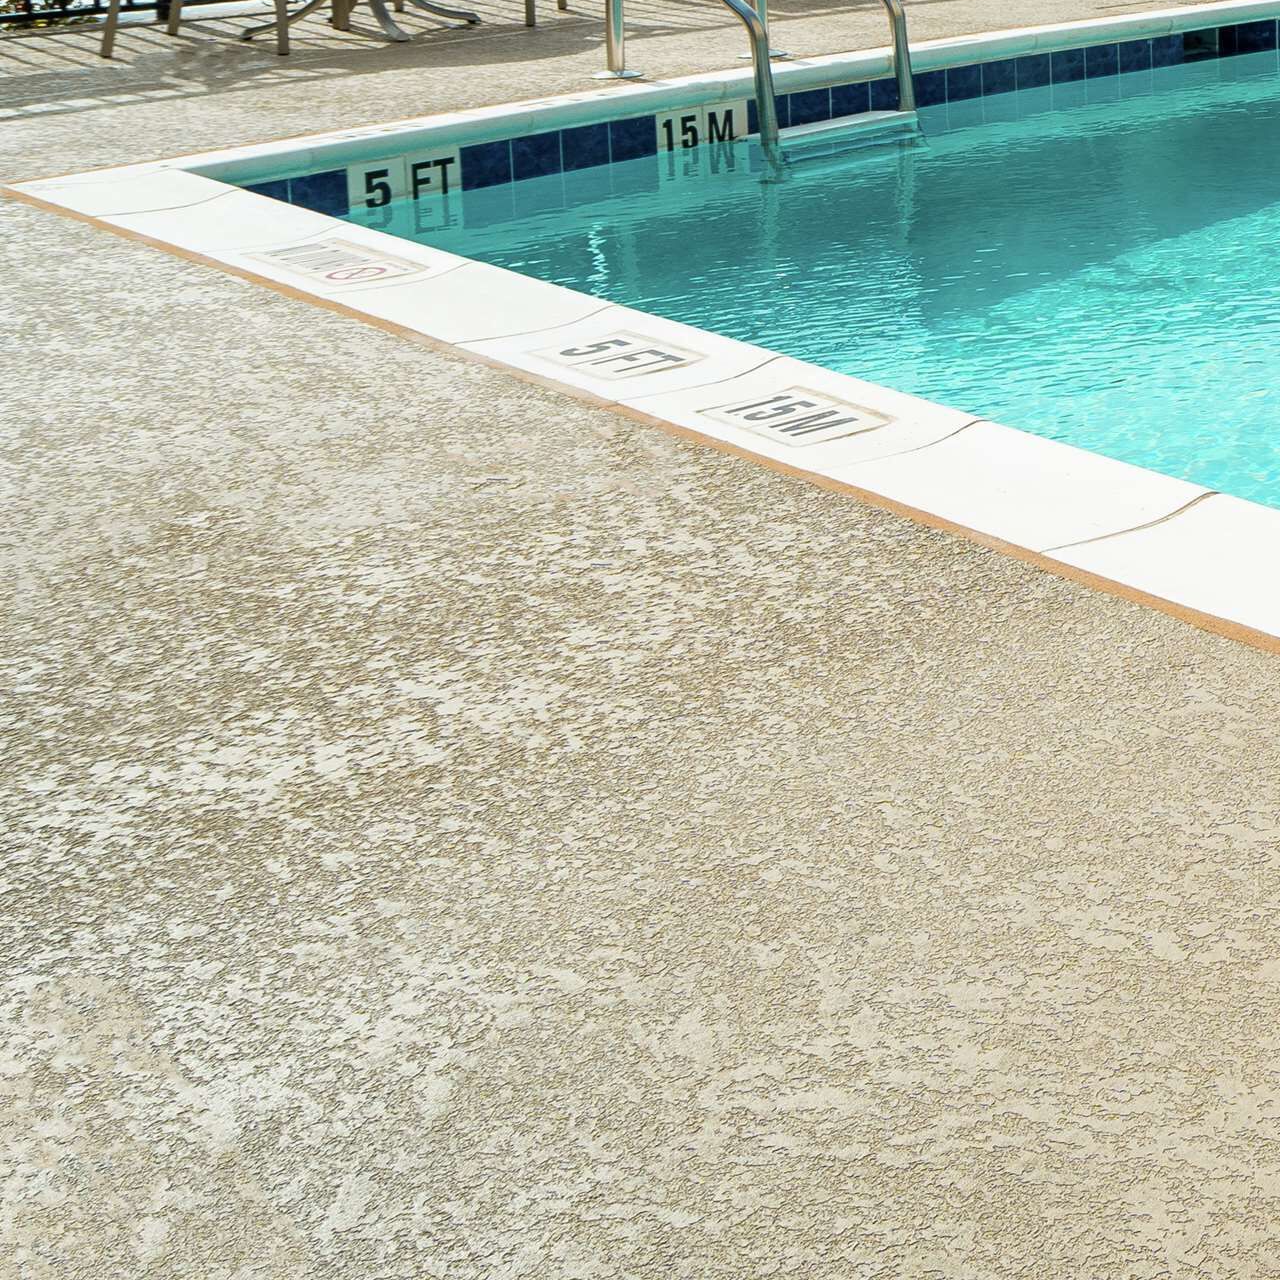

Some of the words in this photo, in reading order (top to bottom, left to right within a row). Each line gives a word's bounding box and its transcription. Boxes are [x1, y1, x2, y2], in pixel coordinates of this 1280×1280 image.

[364, 169, 392, 208] 5
[411, 157, 455, 201] FT
[560, 338, 632, 356] 5
[592, 349, 687, 373] FT
